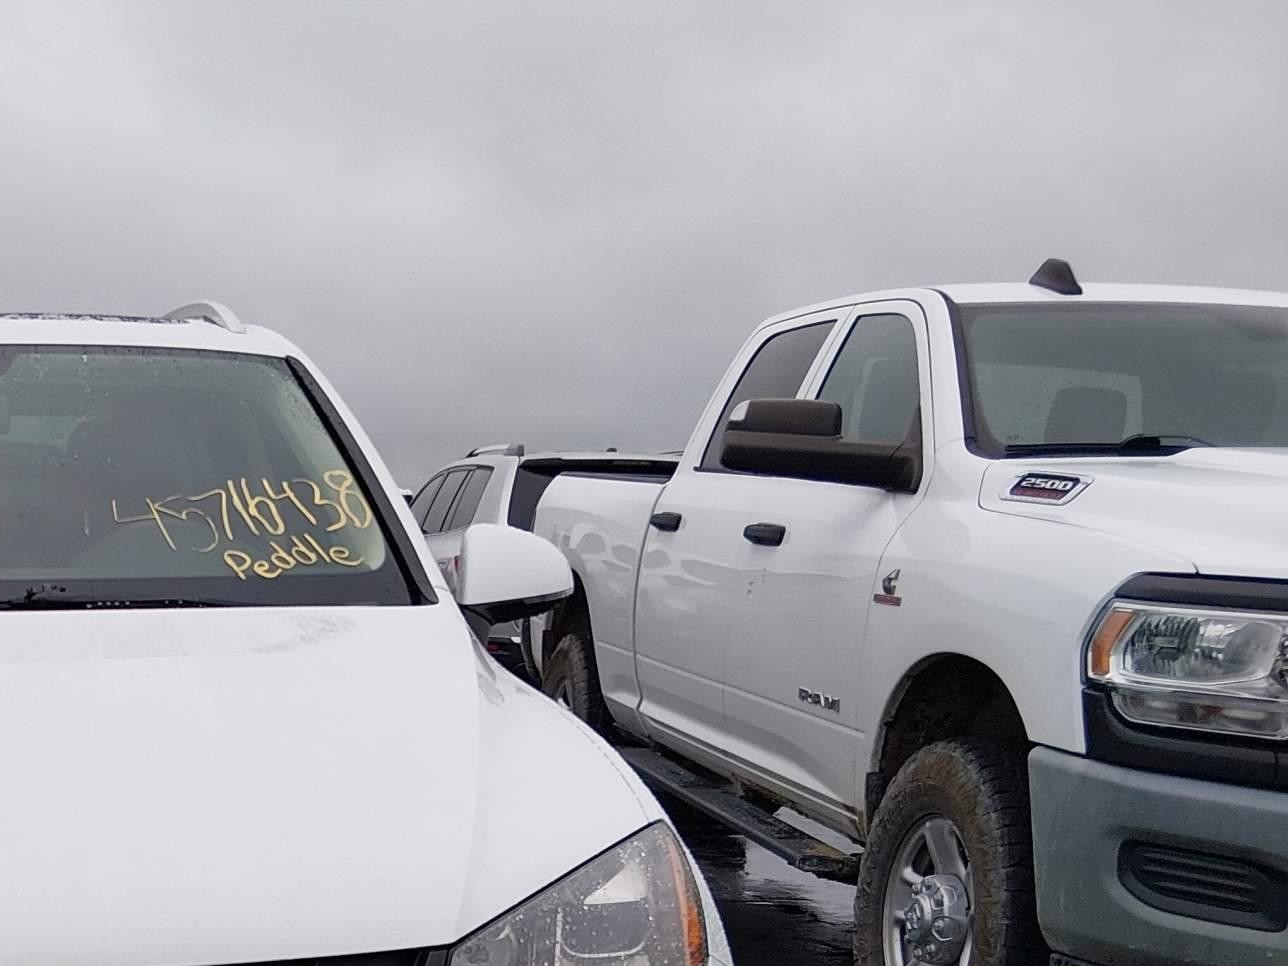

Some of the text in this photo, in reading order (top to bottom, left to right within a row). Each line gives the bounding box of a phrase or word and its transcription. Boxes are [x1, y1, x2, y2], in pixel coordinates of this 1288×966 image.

[1020, 477, 1074, 491] 2500
[112, 470, 372, 552] 45716438
[223, 532, 364, 580] Peddle
[798, 686, 840, 714] RAM
